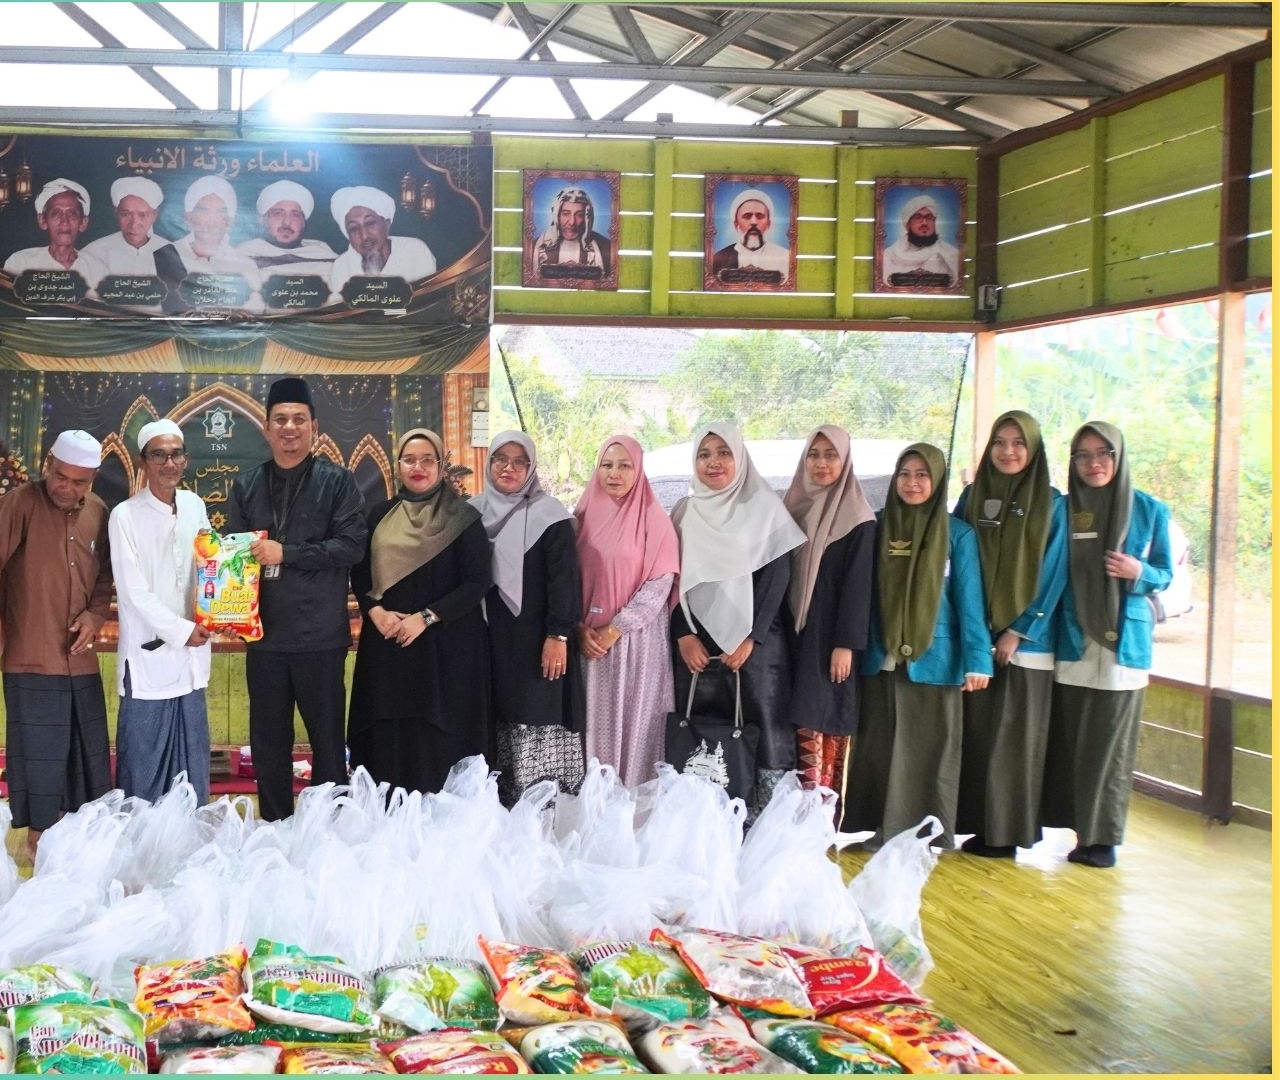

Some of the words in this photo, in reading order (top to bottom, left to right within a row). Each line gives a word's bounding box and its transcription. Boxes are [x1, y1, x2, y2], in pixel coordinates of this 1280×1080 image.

[115, 146, 186, 174] الانبياء
[192, 145, 241, 177] ورثة
[247, 149, 320, 173] العلماء
[211, 443, 228, 451] TSN
[195, 458, 240, 478] مجلس
[210, 602, 249, 615] Dewa
